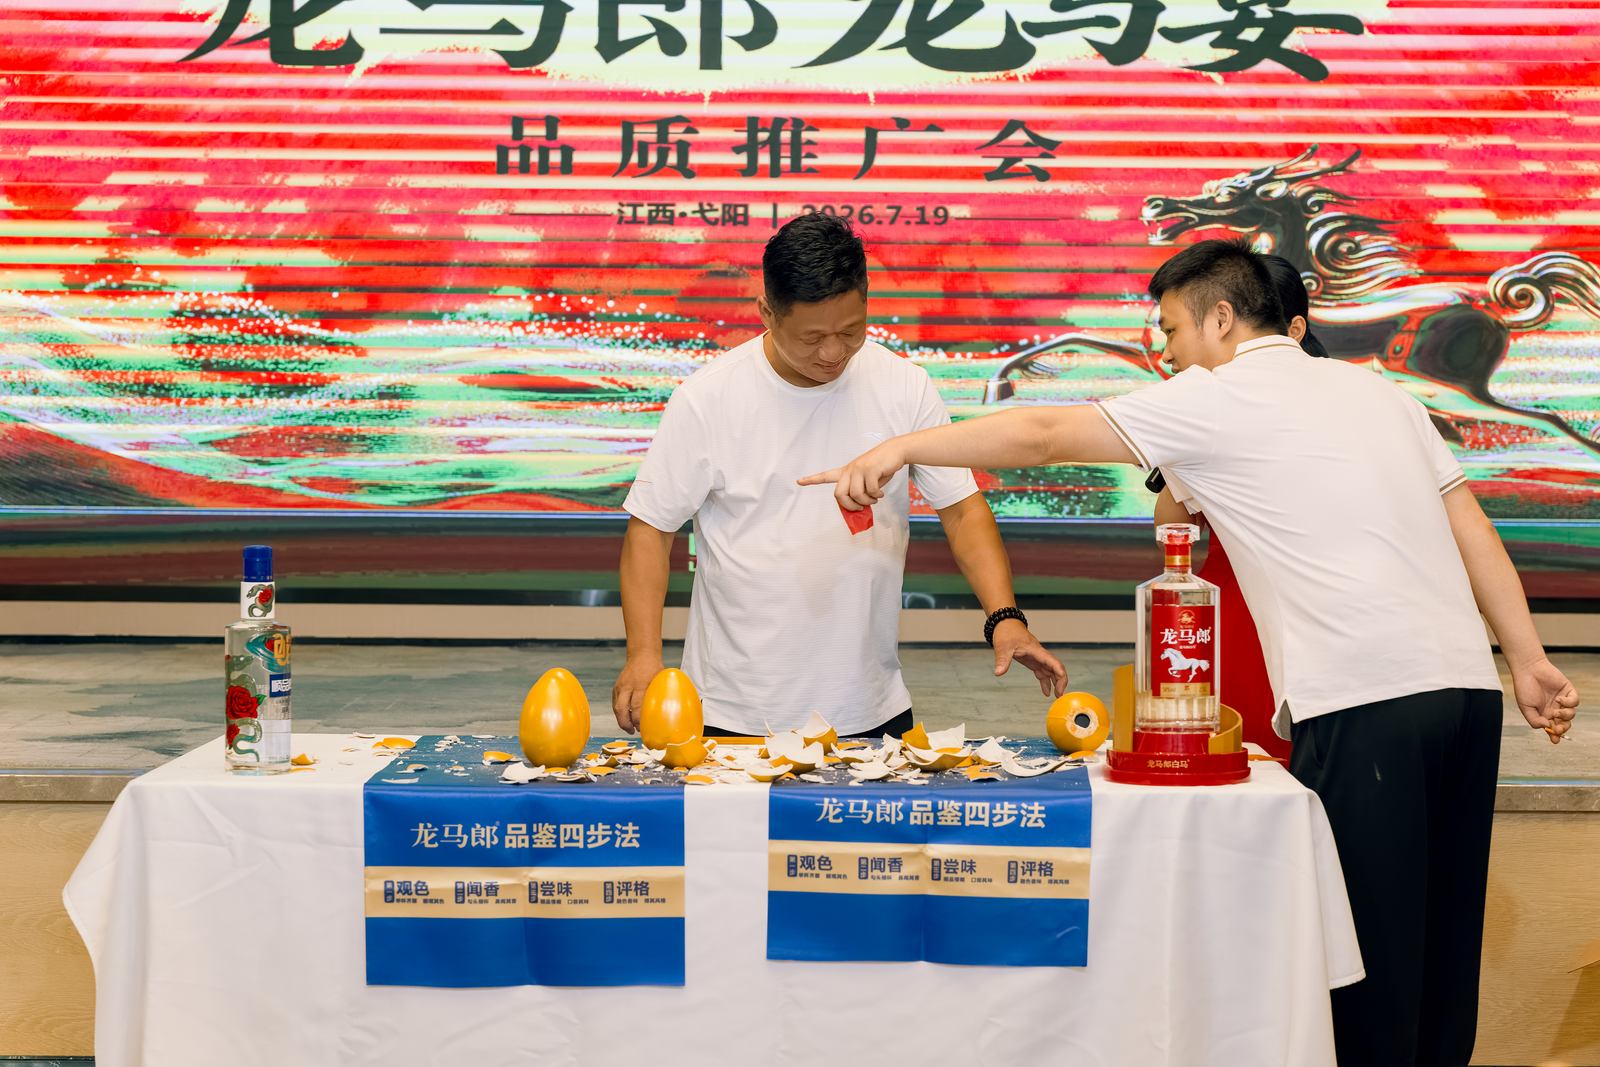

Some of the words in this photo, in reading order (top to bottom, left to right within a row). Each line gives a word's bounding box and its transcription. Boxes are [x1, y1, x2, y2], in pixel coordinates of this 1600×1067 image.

[496, 115, 1062, 182] 品质推广会
[1160, 627, 1211, 645] 龙马郎
[799, 855, 833, 871] 观色
[870, 857, 904, 873] 闻香
[943, 858, 977, 875] 尝味
[1020, 860, 1054, 877] 评格
[396, 880, 430, 897] 观色
[466, 881, 500, 897] 闻香
[540, 881, 573, 897] 尝味
[616, 881, 650, 897] 评格
